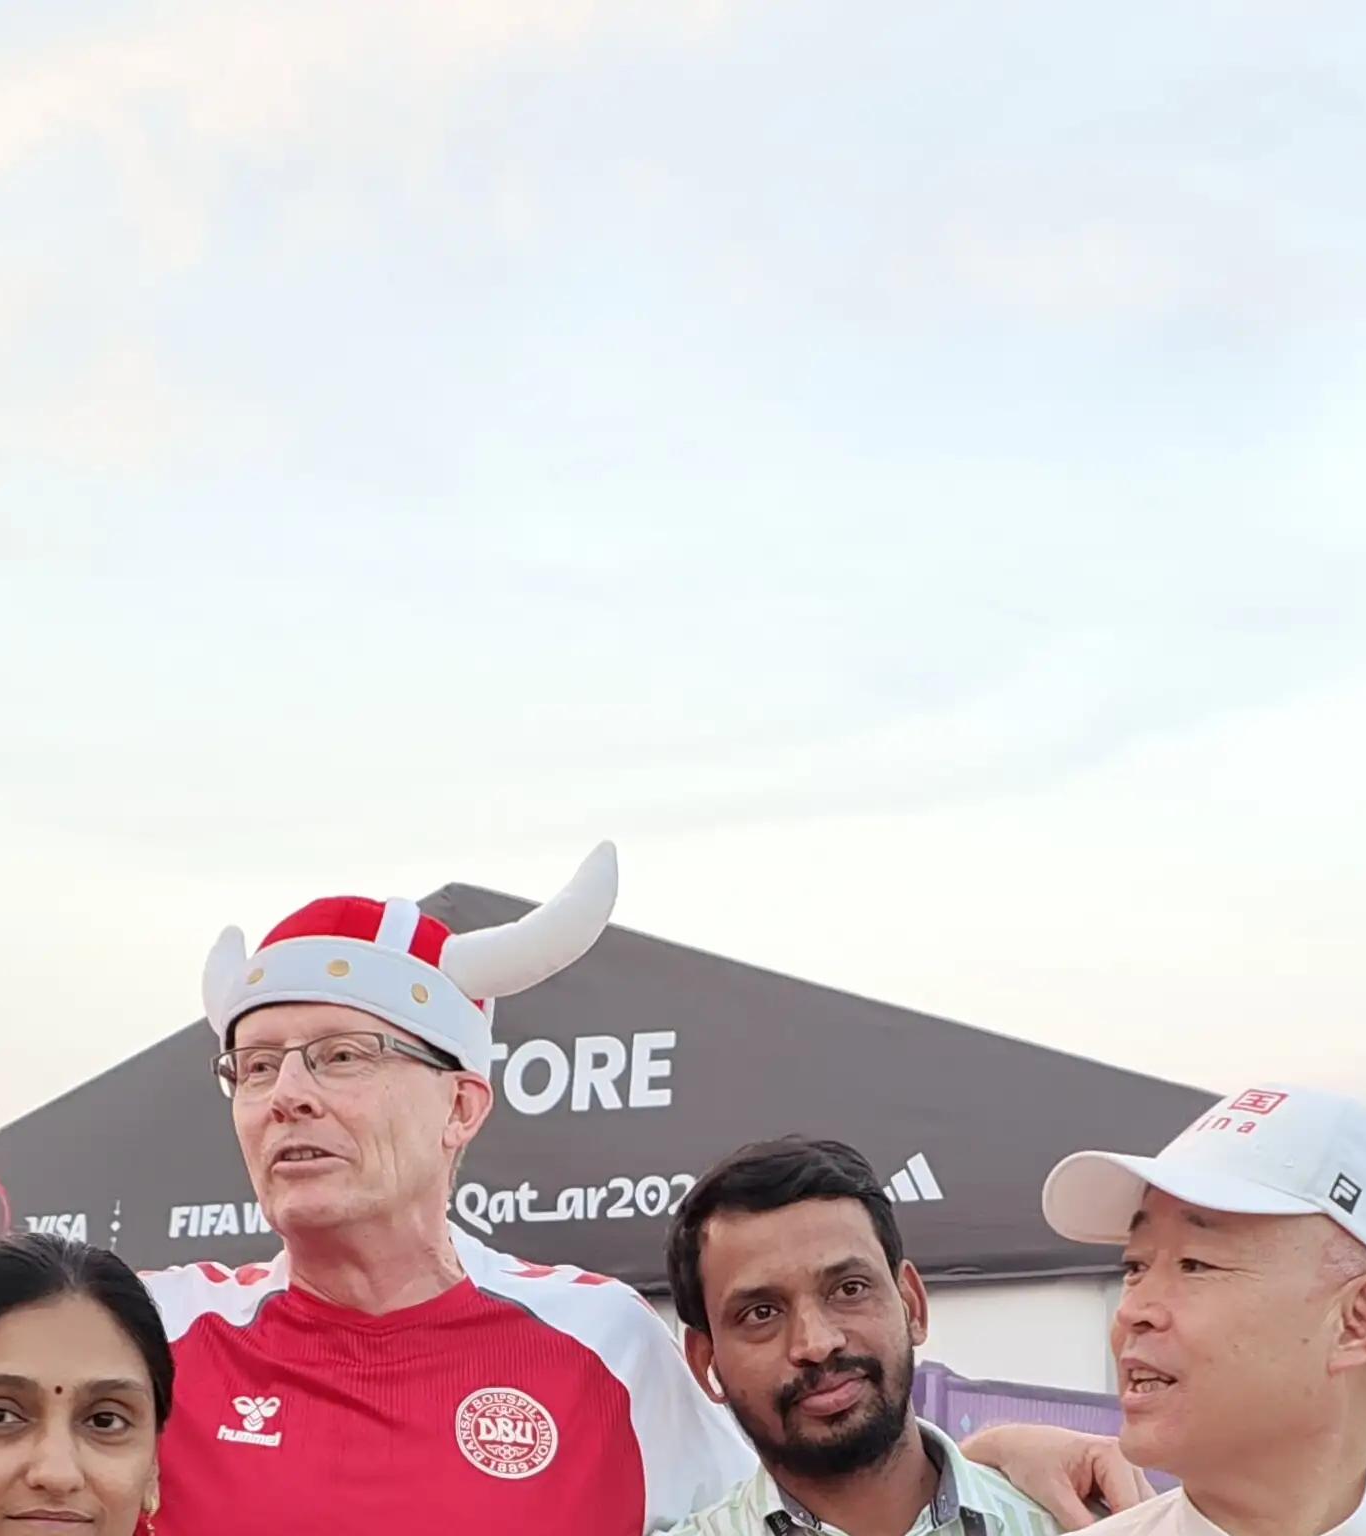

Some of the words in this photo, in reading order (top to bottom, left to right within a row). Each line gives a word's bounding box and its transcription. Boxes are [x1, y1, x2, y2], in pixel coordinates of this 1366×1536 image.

[490, 1031, 676, 1114] ORE
[169, 1204, 239, 1238] FIFA
[455, 1174, 697, 1235] Qatar202
[25, 1214, 87, 1244] VISA
[217, 1424, 282, 1447] hummel
[478, 1417, 535, 1445] DBU
[489, 1461, 529, 1473] 1889
